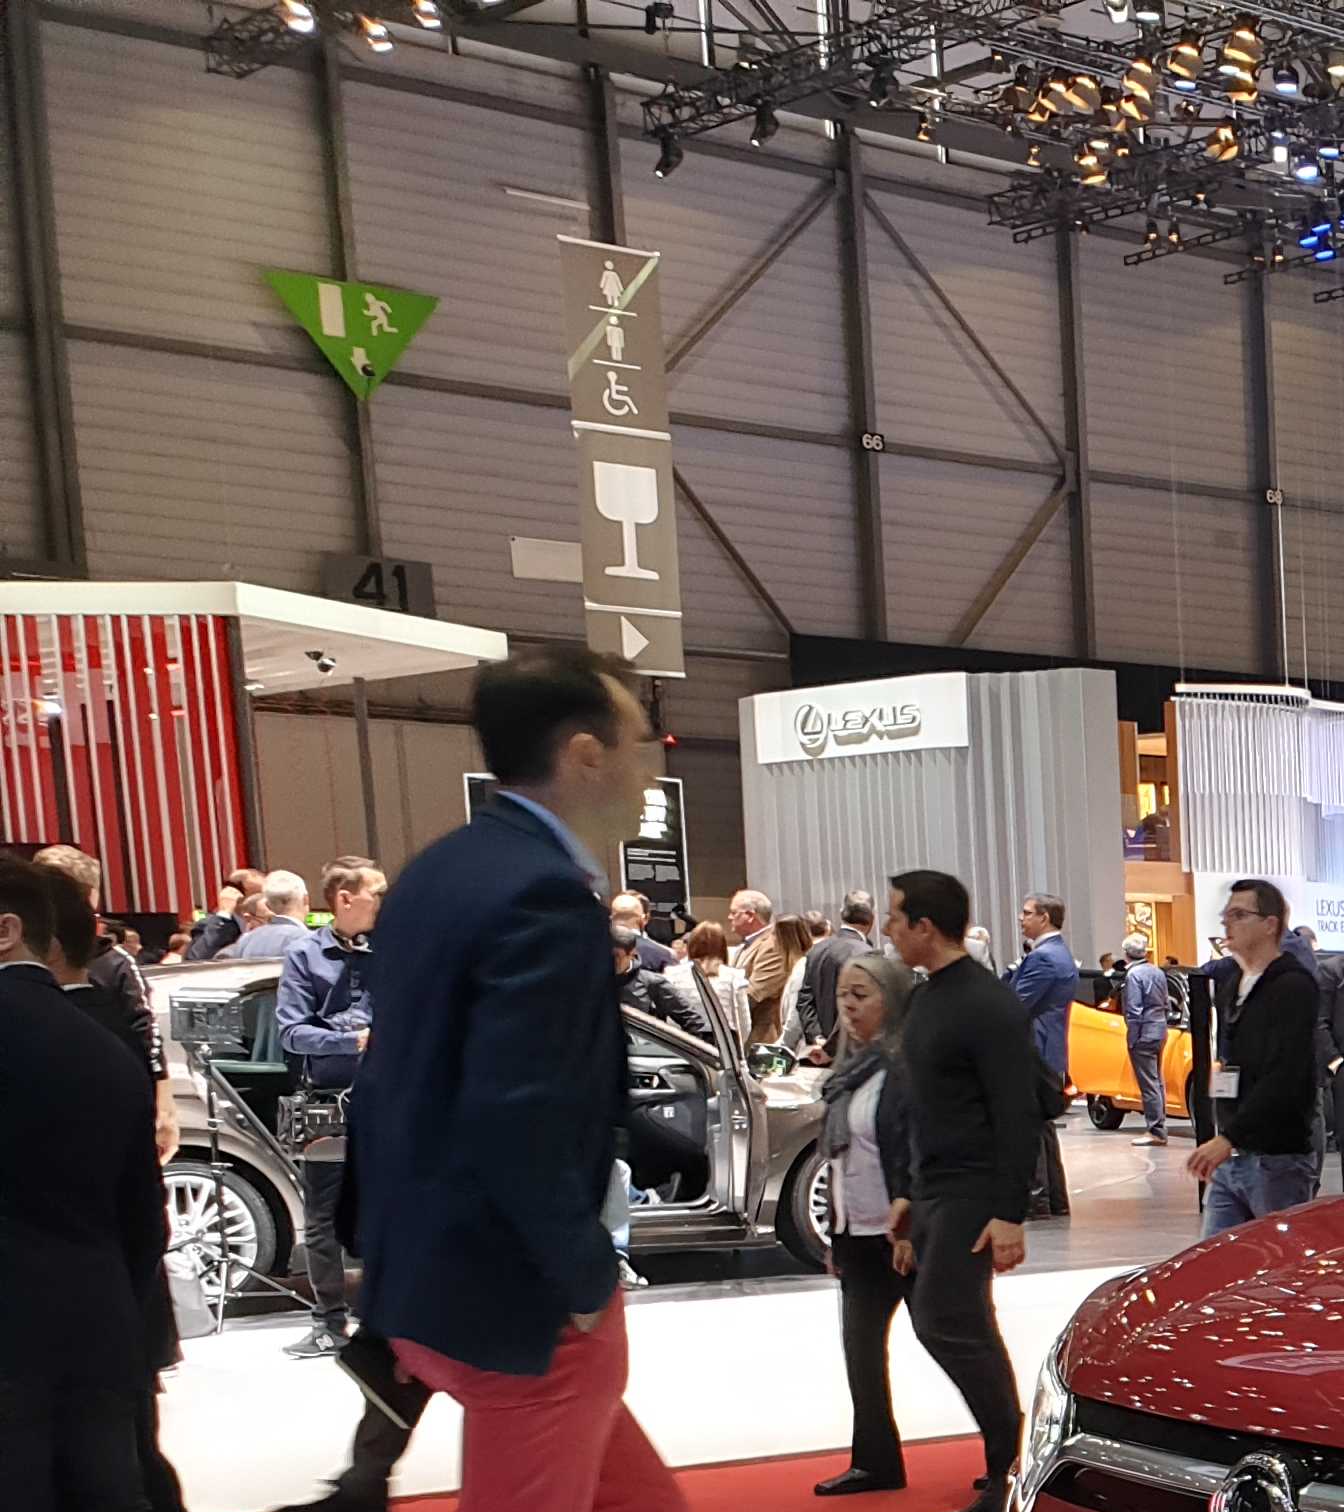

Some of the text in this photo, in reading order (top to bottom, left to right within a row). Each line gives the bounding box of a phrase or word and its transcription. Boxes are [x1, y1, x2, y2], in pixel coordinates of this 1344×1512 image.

[863, 433, 883, 450] 66
[352, 562, 409, 612] 41
[828, 704, 922, 736] LEXUS
